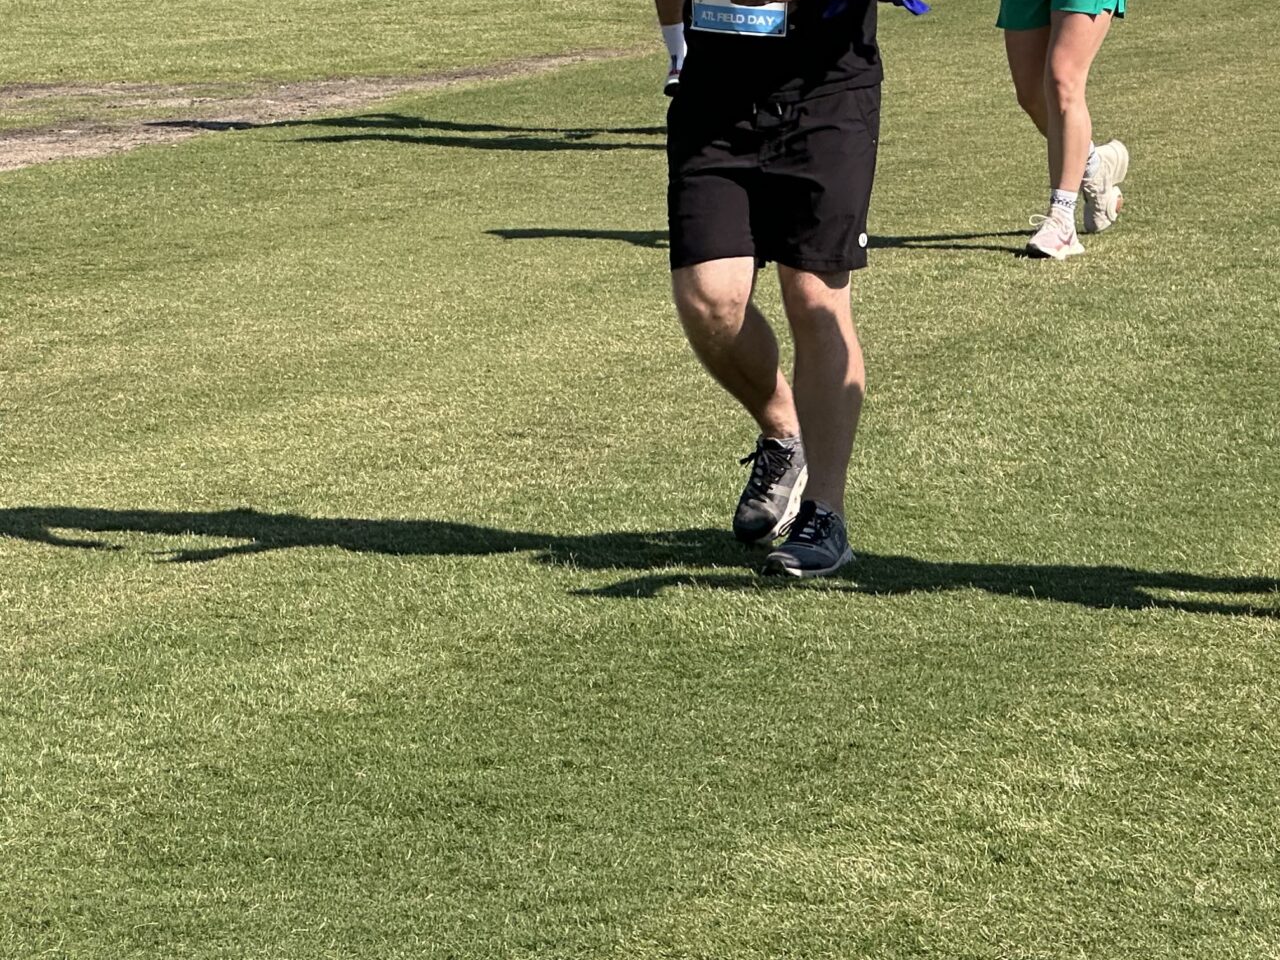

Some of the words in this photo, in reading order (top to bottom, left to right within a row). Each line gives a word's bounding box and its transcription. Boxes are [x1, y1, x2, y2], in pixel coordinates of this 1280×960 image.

[701, 10, 715, 21] ATL
[716, 13, 745, 24] FIELD
[747, 15, 775, 26] DAY
